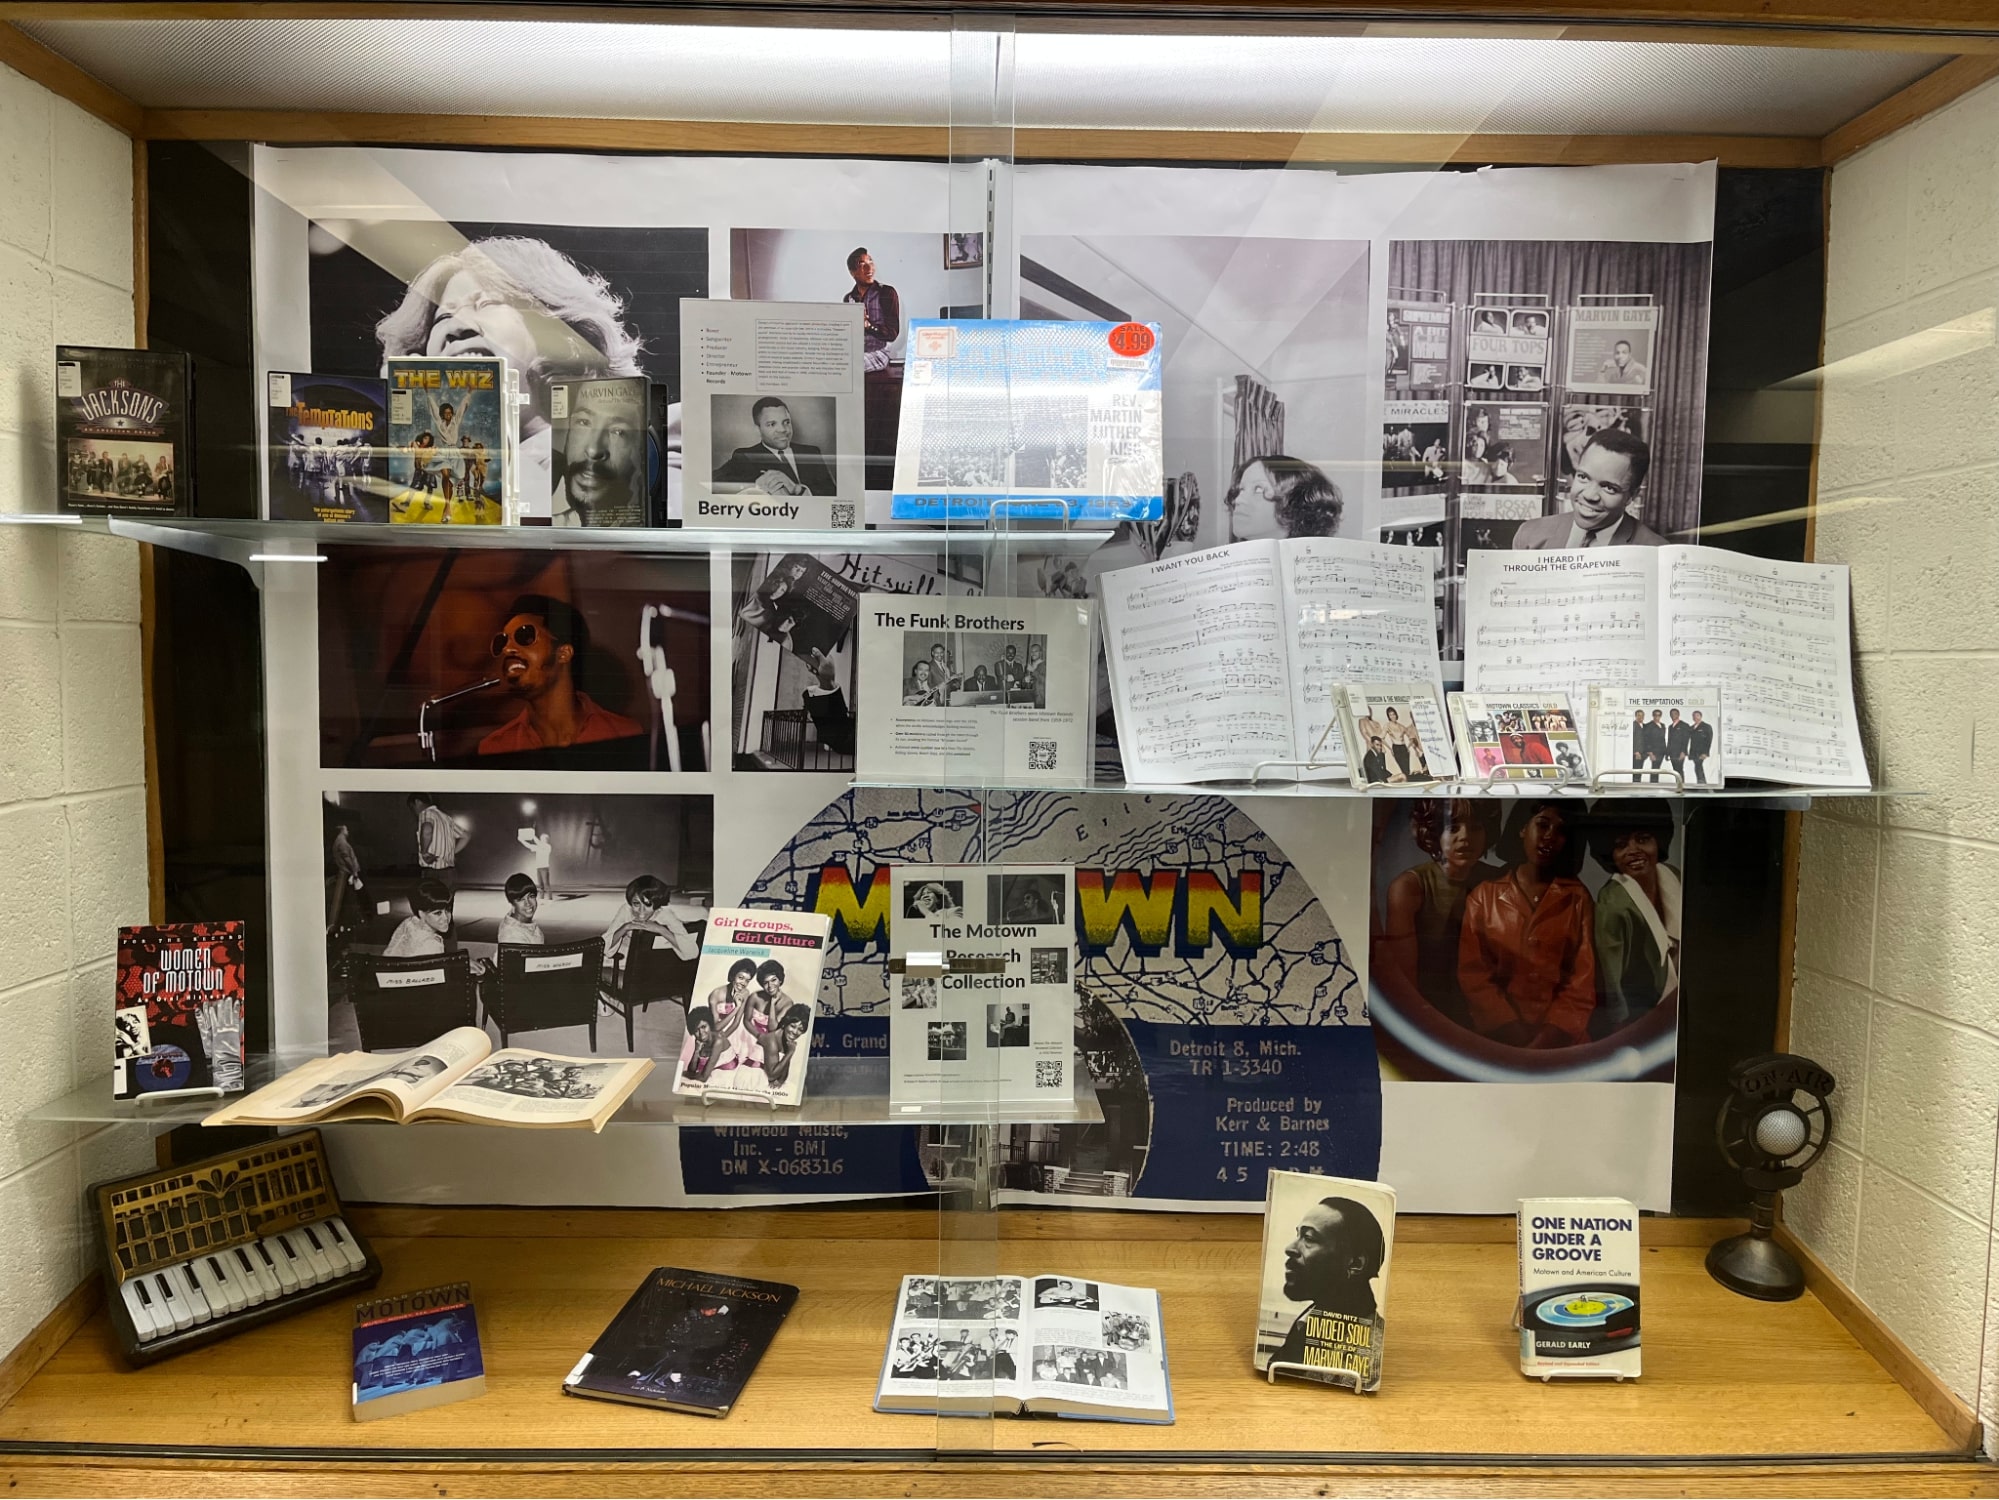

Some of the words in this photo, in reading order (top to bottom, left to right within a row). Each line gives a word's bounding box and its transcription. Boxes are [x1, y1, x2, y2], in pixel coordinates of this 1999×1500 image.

[1575, 309, 1619, 322] MARVIN
[1623, 309, 1651, 322] GAYE
[1120, 325, 1146, 333] SALE
[1111, 331, 1151, 351] $4.99
[1473, 336, 1508, 352] FOUR
[1511, 339, 1545, 355] TOPS
[394, 369, 441, 389] THE
[446, 370, 494, 389] WIZ
[81, 389, 164, 424] JACKSONS
[1391, 408, 1448, 416] MIRACLES
[1090, 409, 1142, 423] MARTIN
[915, 497, 993, 506] DETROIT
[1495, 499, 1537, 510] BOSSA
[699, 501, 744, 519] Berry
[748, 501, 799, 520] Gordy
[1155, 561, 1182, 573] WANT
[1185, 556, 1204, 566] YOU
[1206, 550, 1230, 561] BACK
[1504, 564, 1548, 572] THROUGH
[1550, 563, 1567, 571] THE
[1570, 560, 1621, 570] GRAPEVINE
[874, 612, 905, 627] The
[910, 613, 949, 628] Funk
[954, 615, 1025, 631] Brothers
[1642, 698, 1684, 706] TEMPTATIONS
[713, 917, 739, 928] Girl
[742, 918, 794, 932] Groups,
[929, 923, 962, 939] The
[966, 923, 1037, 938] Motown
[193, 934, 242, 942] RECORD
[735, 932, 761, 944] Girl
[764, 934, 816, 947] Culture
[160, 947, 211, 972] WOMEN
[142, 971, 159, 994] OF
[165, 968, 223, 994] MOTOWN
[941, 974, 1026, 989] Collection
[811, 1033, 830, 1048] W.
[842, 1033, 887, 1049] Grand
[1169, 1039, 1225, 1057] Detroit
[1233, 1040, 1250, 1058] 8,
[1259, 1040, 1302, 1056] Mich.
[1189, 1060, 1213, 1075] TR
[1222, 1059, 1282, 1075] 1-3340
[1227, 1097, 1294, 1113] Produced
[1303, 1098, 1323, 1115] by
[1216, 1116, 1249, 1132] Kerr
[1257, 1116, 1270, 1131] &
[1280, 1116, 1330, 1131] Barnes
[733, 1142, 762, 1156] Inc.
[793, 1141, 827, 1156] BMI
[1221, 1141, 1272, 1157] TIME:
[1280, 1141, 1320, 1157] 2:48
[721, 1159, 748, 1176] DM
[758, 1158, 844, 1176] X-068316
[1531, 1217, 1566, 1230] ONE
[1570, 1217, 1633, 1232] NATION
[1532, 1232, 1585, 1246] UNDER
[1590, 1233, 1602, 1246] A
[1532, 1247, 1602, 1262] GROOVE
[1561, 1268, 1575, 1276] and
[1576, 1268, 1607, 1277] American
[1609, 1269, 1632, 1277] Culture
[656, 1277, 714, 1294] MICHAEL
[718, 1287, 782, 1304] JACKSON
[356, 1287, 470, 1324] MOTOWN
[1322, 1310, 1342, 1319] DAVID
[1343, 1314, 1358, 1322] RITZ
[1306, 1315, 1345, 1342] DIVIDED
[1346, 1322, 1371, 1348] SOUL
[1320, 1340, 1333, 1348] THE
[1334, 1343, 1347, 1351] LIFE
[1347, 1345, 1357, 1353] OF
[1535, 1340, 1566, 1349] GERALD
[1568, 1341, 1591, 1350] EARLY
[1304, 1346, 1343, 1369] MARVIN
[1345, 1353, 1370, 1377] GAYE
